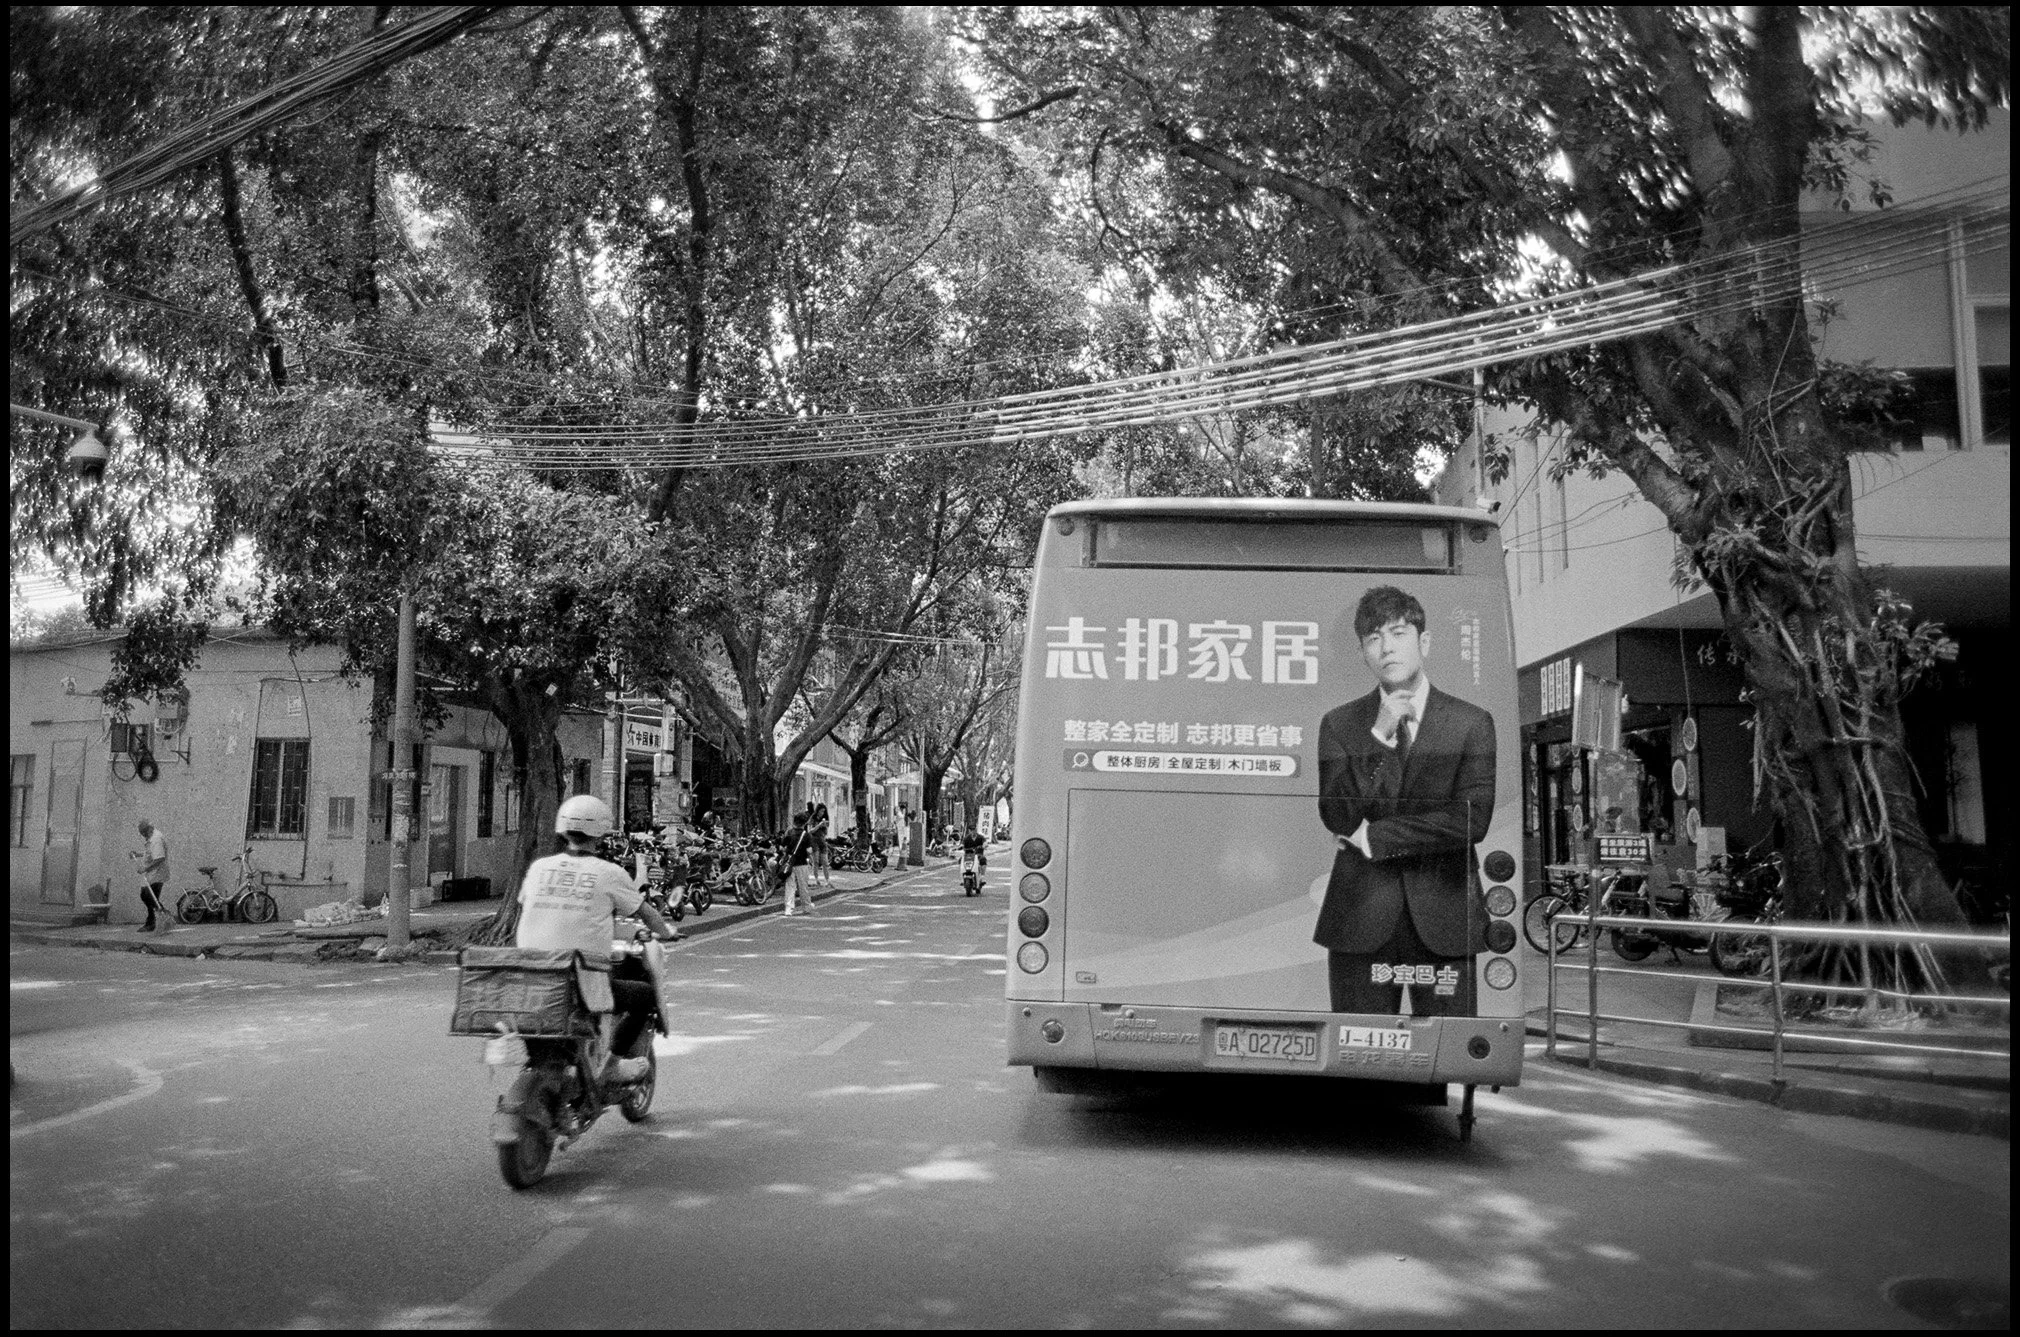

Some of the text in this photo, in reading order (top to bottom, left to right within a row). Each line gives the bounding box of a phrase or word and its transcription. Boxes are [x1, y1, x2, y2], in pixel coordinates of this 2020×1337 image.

[1045, 617, 1319, 685] 志邦家居
[1064, 719, 1302, 747] 整家全定制 志邦更省事
[1107, 755, 1282, 772] 整体厨房 全屋定制 木门墙板
[1371, 963, 1459, 984] 珍宝巴士
[1340, 1030, 1410, 1049] J-4137
